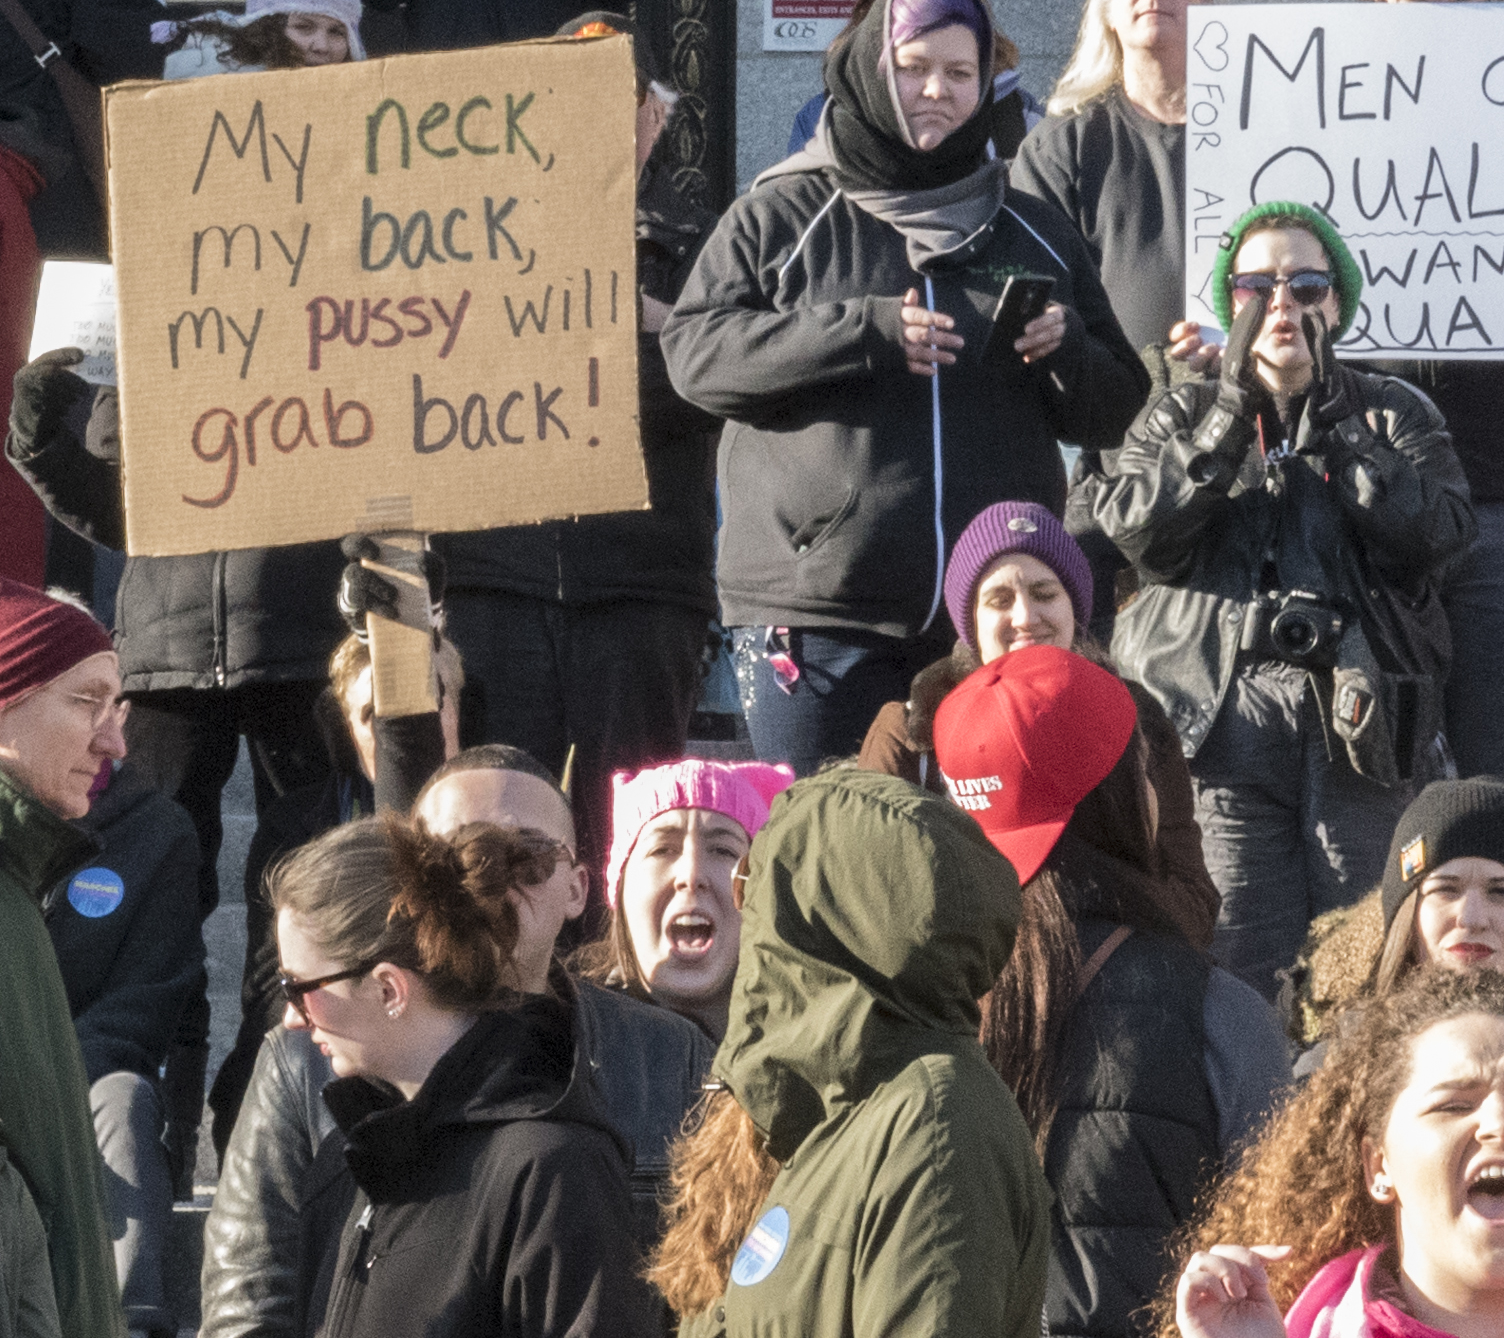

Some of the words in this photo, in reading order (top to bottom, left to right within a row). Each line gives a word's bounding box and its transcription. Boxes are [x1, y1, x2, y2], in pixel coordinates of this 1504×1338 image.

[1191, 82, 1223, 152] FOR
[1239, 27, 1426, 129] MEN
[191, 99, 313, 203] My
[365, 91, 556, 175] neck,
[190, 222, 311, 295] my
[1191, 188, 1225, 255] ALL
[166, 306, 265, 380] my
[304, 289, 472, 371] pussy
[504, 267, 618, 339] will
[182, 386, 376, 509] grab
[412, 356, 600, 455] back!
